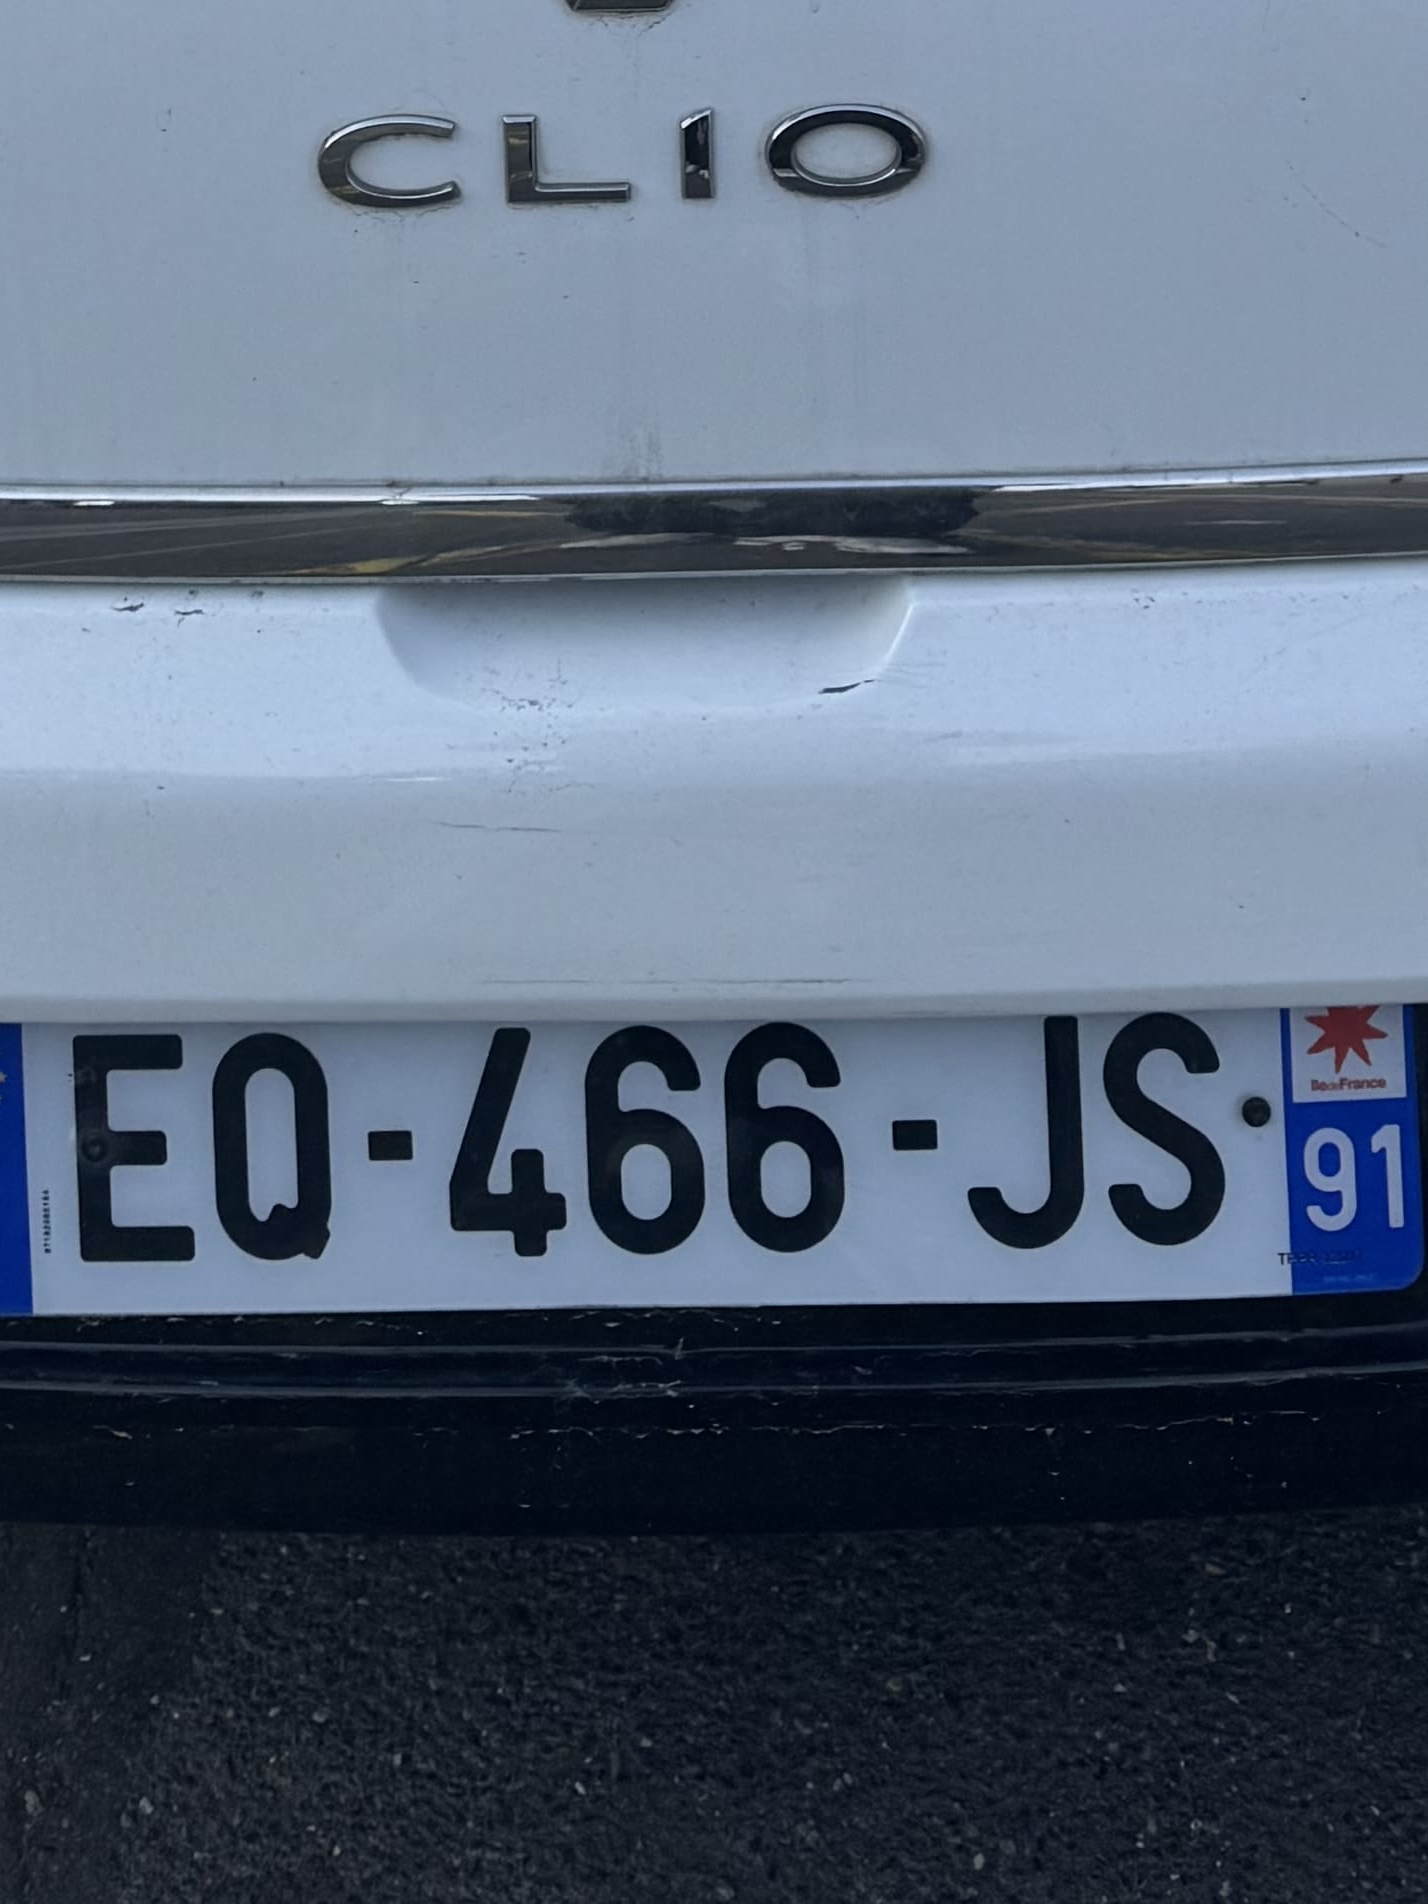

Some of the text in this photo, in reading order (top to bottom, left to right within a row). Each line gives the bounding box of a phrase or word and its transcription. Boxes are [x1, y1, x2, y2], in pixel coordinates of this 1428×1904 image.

[317, 103, 929, 209] CLIO
[73, 1012, 1226, 1262] EQ-466-JS
[1303, 1124, 1405, 1232] 91
